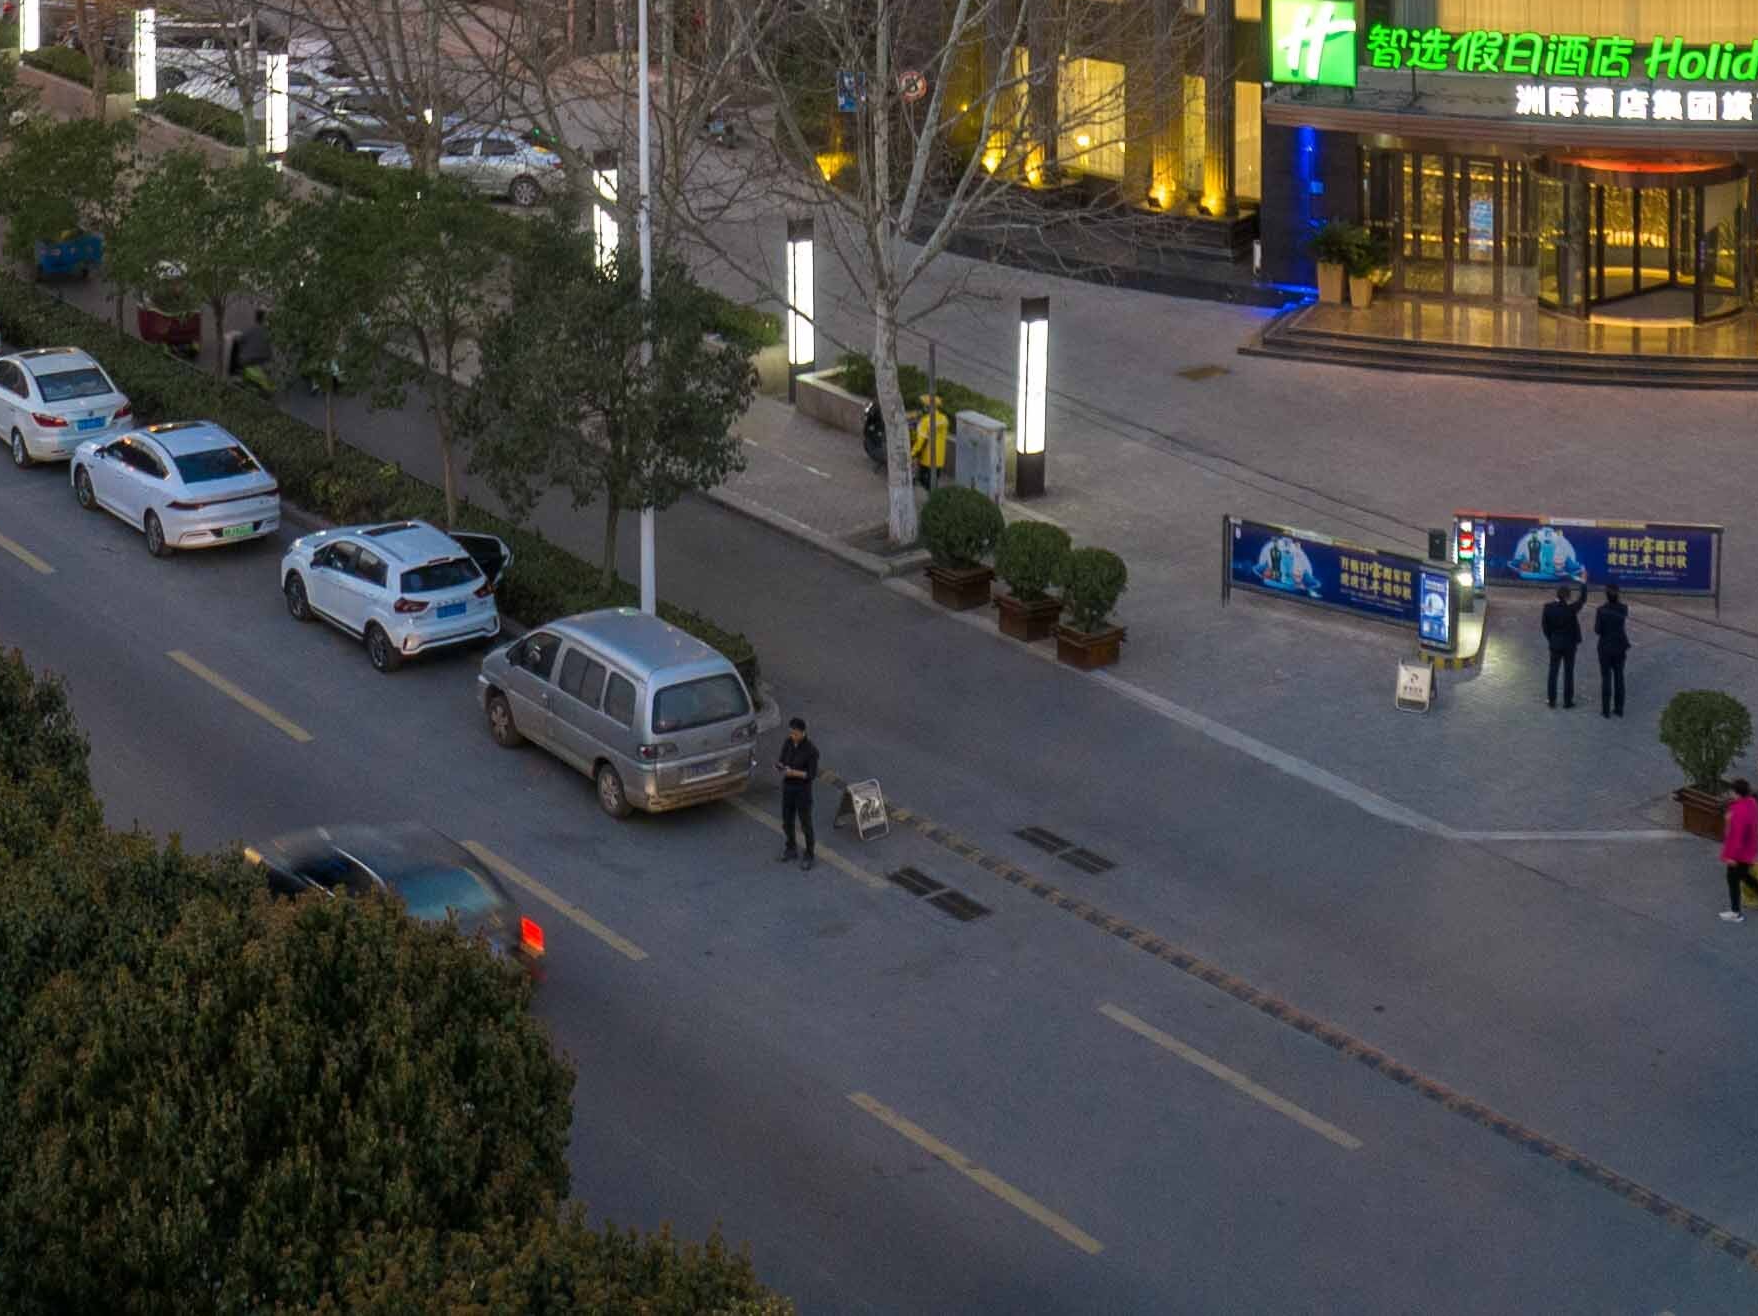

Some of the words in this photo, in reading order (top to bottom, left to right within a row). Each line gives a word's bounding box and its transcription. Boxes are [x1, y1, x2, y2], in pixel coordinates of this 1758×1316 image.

[1368, 23, 1634, 79] 智选假日酒店
